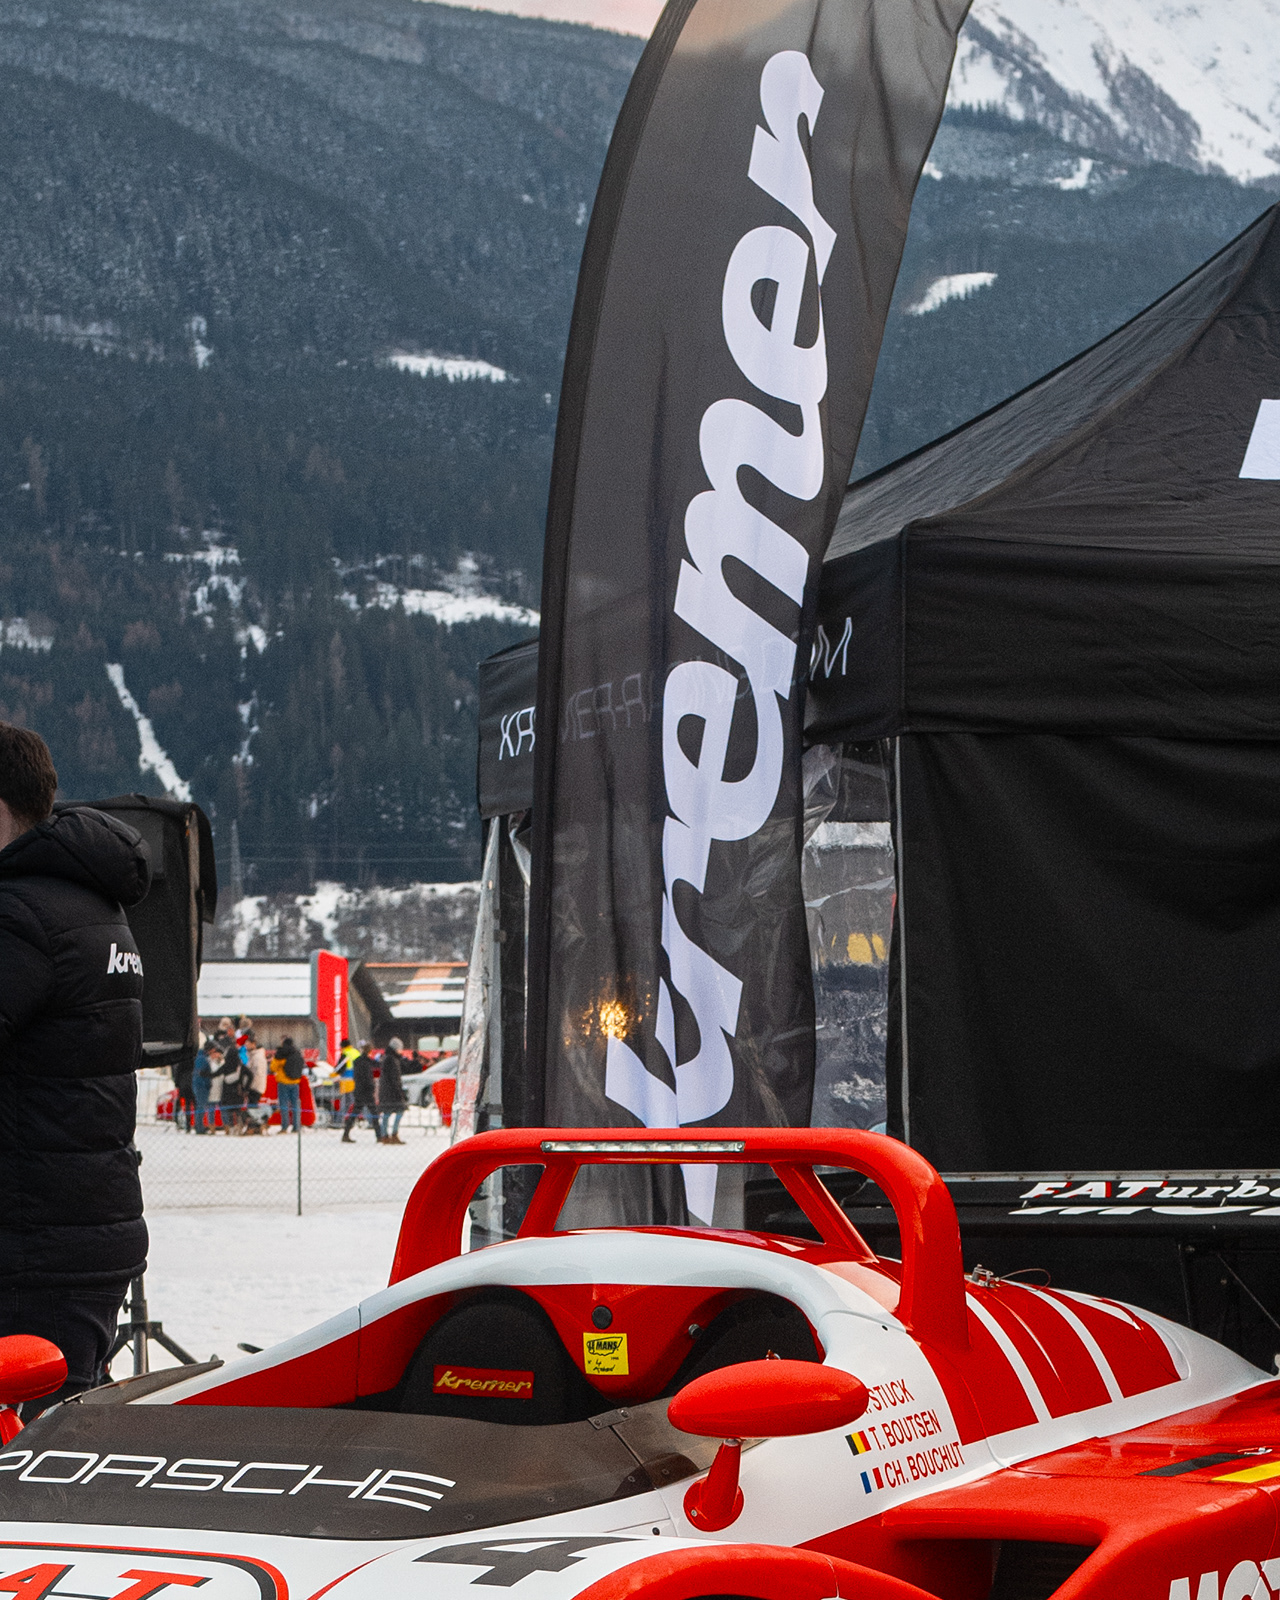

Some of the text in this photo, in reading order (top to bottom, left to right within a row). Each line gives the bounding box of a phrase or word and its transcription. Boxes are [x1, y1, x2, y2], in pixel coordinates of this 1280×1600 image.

[605, 48, 838, 1225] kremer
[435, 1370, 531, 1394] kremer
[868, 1379, 915, 1411] STUCK
[868, 1409, 942, 1451] T. BOUTSEN
[884, 1441, 965, 1488] CH. BOUCHUT
[411, 1536, 650, 1587] 4
